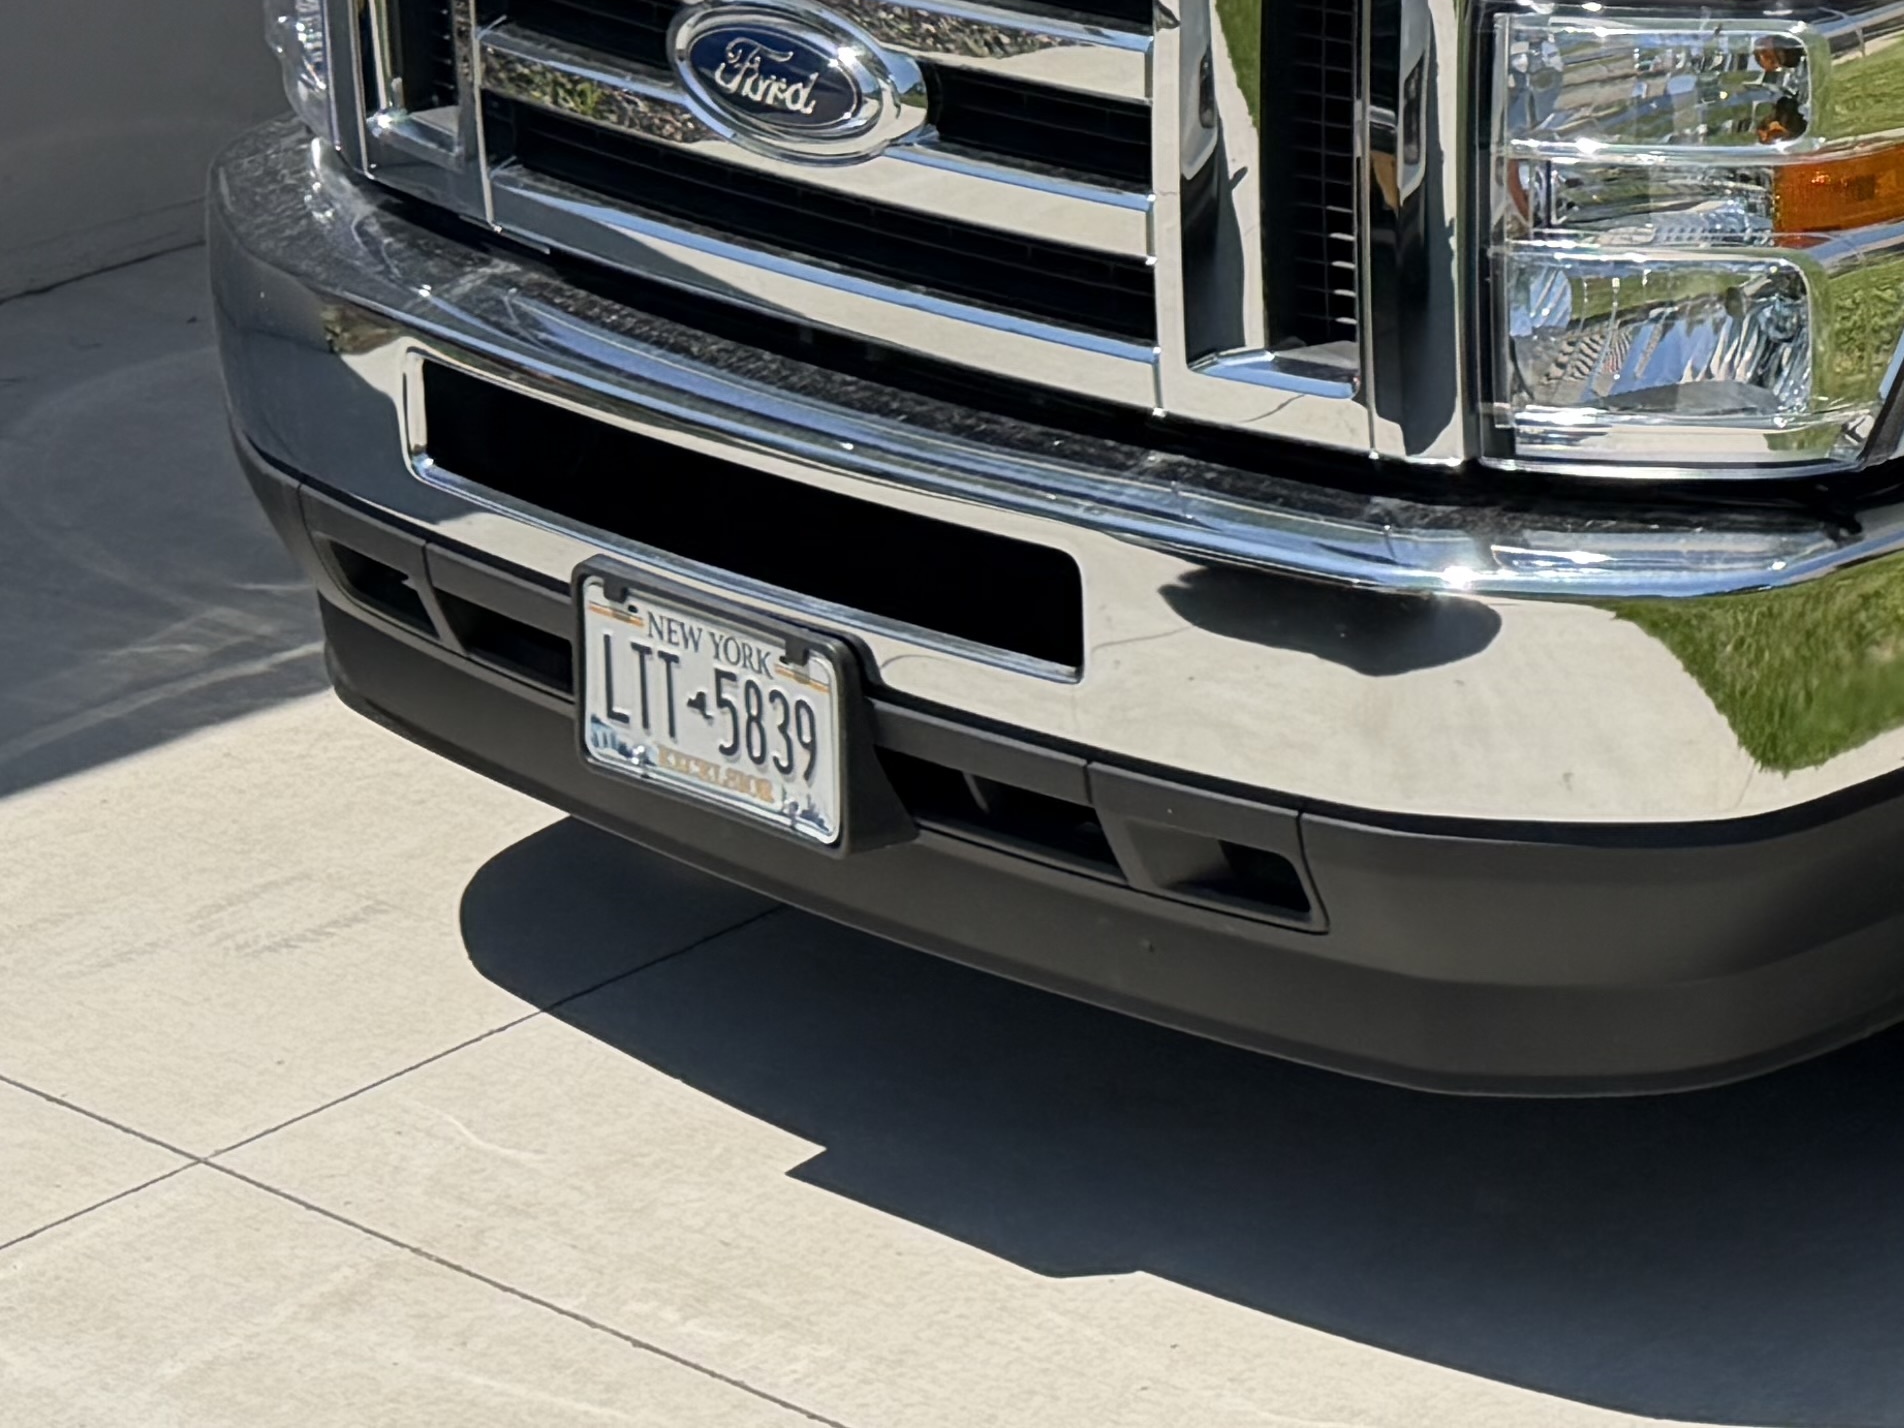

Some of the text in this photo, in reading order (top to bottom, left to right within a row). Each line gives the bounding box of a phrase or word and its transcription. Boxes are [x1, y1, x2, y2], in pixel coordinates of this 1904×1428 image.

[714, 37, 820, 115] Ford
[647, 611, 773, 680] NEW YORK
[714, 667, 817, 782] 5839
